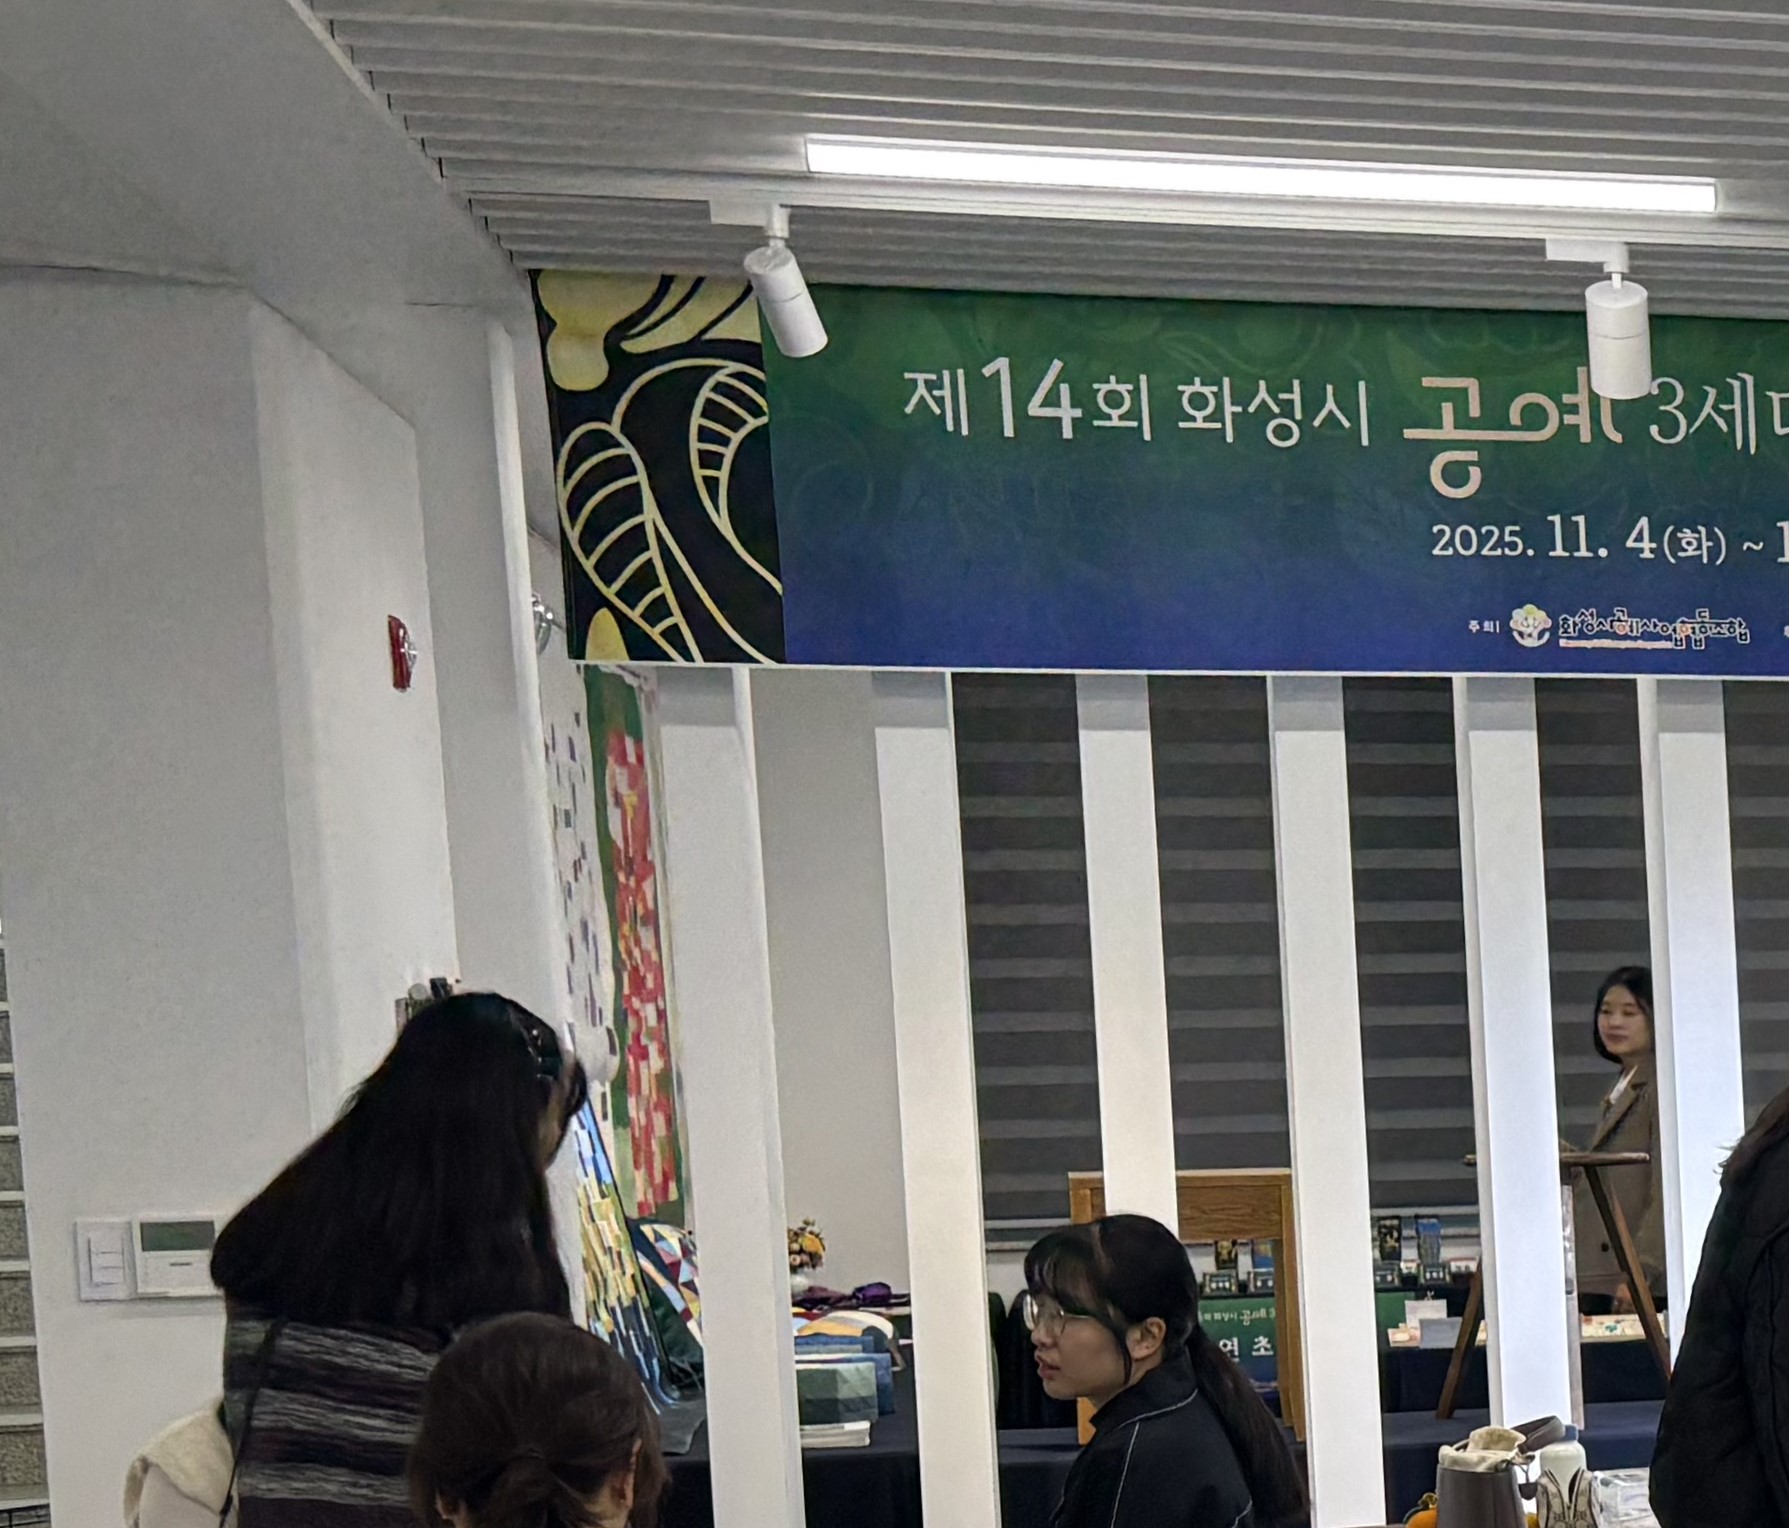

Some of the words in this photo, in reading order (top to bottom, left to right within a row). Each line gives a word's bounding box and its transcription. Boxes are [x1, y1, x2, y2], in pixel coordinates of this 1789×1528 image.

[904, 357, 1152, 442] 제14회
[1178, 376, 1370, 448] 화성시
[1402, 366, 1623, 499] 공예
[1431, 524, 1535, 557] 2025.
[1546, 514, 1609, 558] 11.
[1625, 516, 1727, 566] 4(화)
